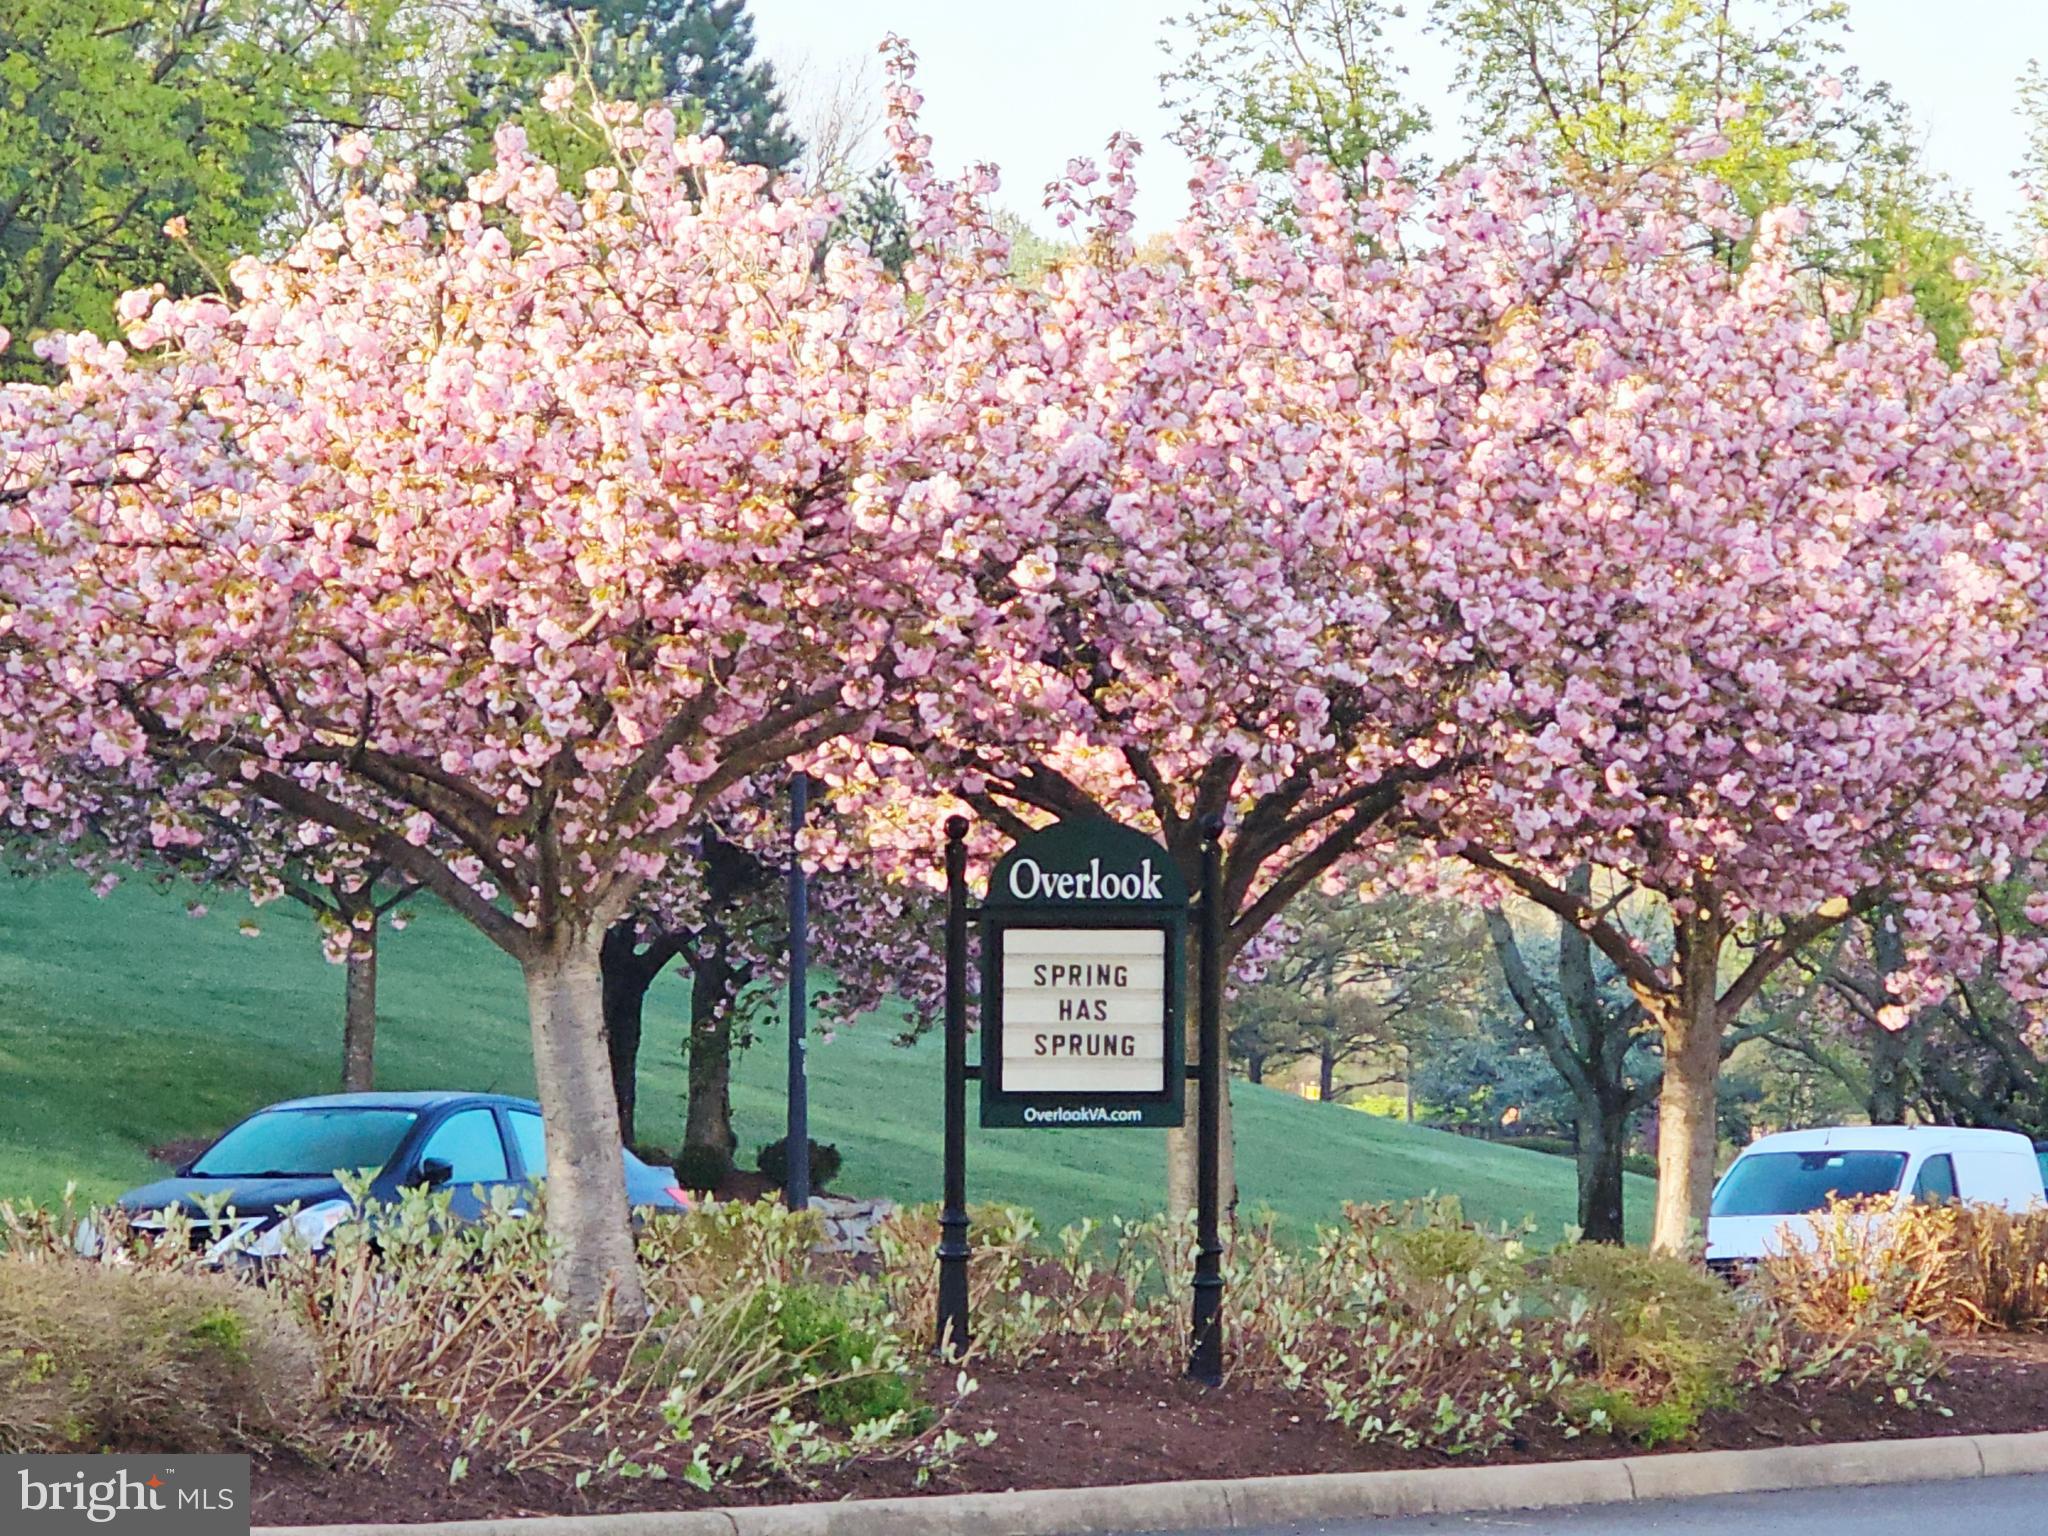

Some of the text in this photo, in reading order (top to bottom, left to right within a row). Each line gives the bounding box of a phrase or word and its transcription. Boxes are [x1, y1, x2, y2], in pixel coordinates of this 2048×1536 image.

[1009, 858, 1163, 900] Overlook
[1034, 964, 1128, 988] SPRING
[1059, 999, 1108, 1021] HAS
[1034, 1034, 1135, 1057] SPRUNG
[1024, 1107, 1142, 1123] OverlookVA.com
